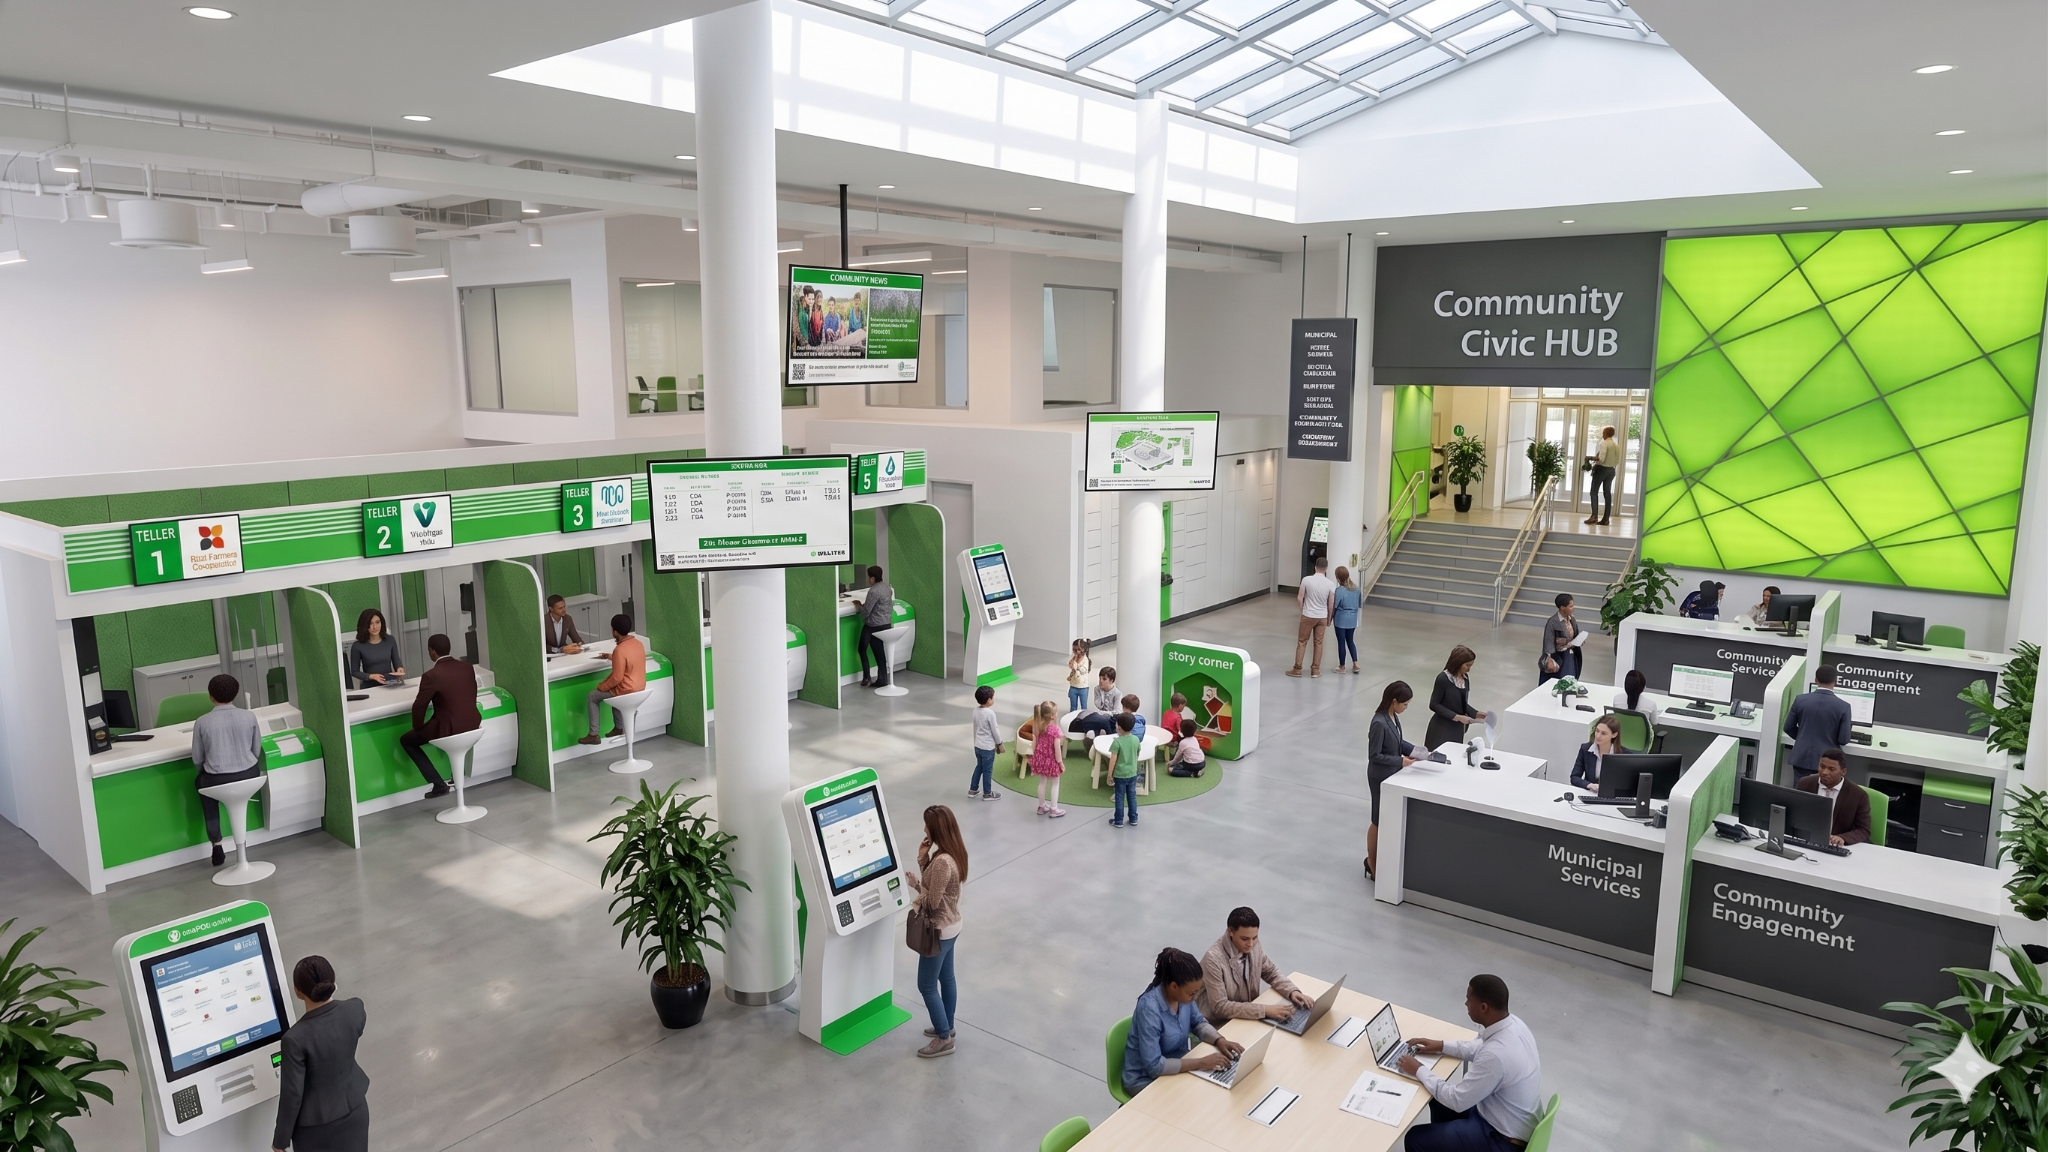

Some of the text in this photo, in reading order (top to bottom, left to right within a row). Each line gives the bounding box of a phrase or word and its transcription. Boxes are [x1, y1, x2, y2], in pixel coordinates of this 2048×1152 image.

[830, 274, 888, 284] COMMUNITY NEWS
[1434, 285, 1624, 322] Community
[1461, 328, 1618, 357] Civic HUB
[861, 458, 876, 467] TELLER
[864, 473, 871, 490] 5
[565, 488, 590, 498] TELLER
[367, 506, 398, 519] TELLER
[573, 504, 584, 526] 3
[136, 528, 176, 542] TELLER
[377, 526, 391, 550] 2
[151, 550, 164, 576] 1
[209, 552, 237, 560] Farmers
[1169, 651, 1234, 670] story corner
[1716, 649, 1788, 668] Community
[1836, 662, 1914, 683] Community
[1836, 675, 1921, 696] Engagement
[1548, 844, 1643, 880] Municipal
[1560, 867, 1641, 900] Services
[1713, 882, 1844, 929] Community
[1712, 902, 1856, 951] Engagement
